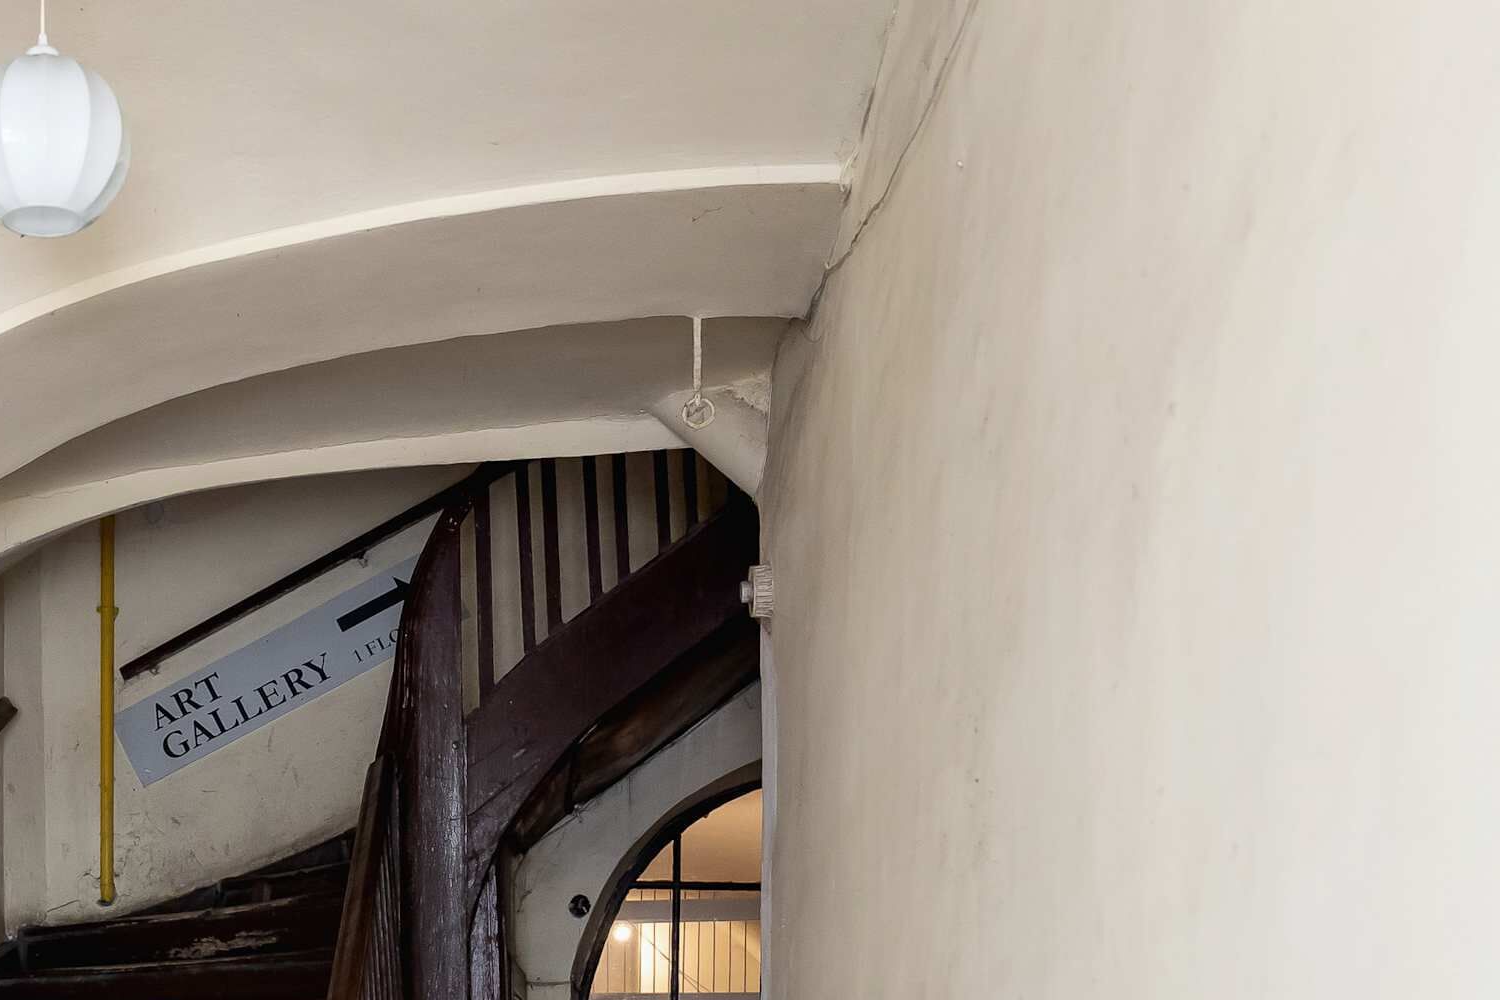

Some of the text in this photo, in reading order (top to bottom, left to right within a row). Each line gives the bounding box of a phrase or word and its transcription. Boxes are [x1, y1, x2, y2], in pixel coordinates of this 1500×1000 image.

[353, 649, 364, 663] 1
[153, 671, 223, 732] ART
[161, 653, 332, 760] GALLERY
